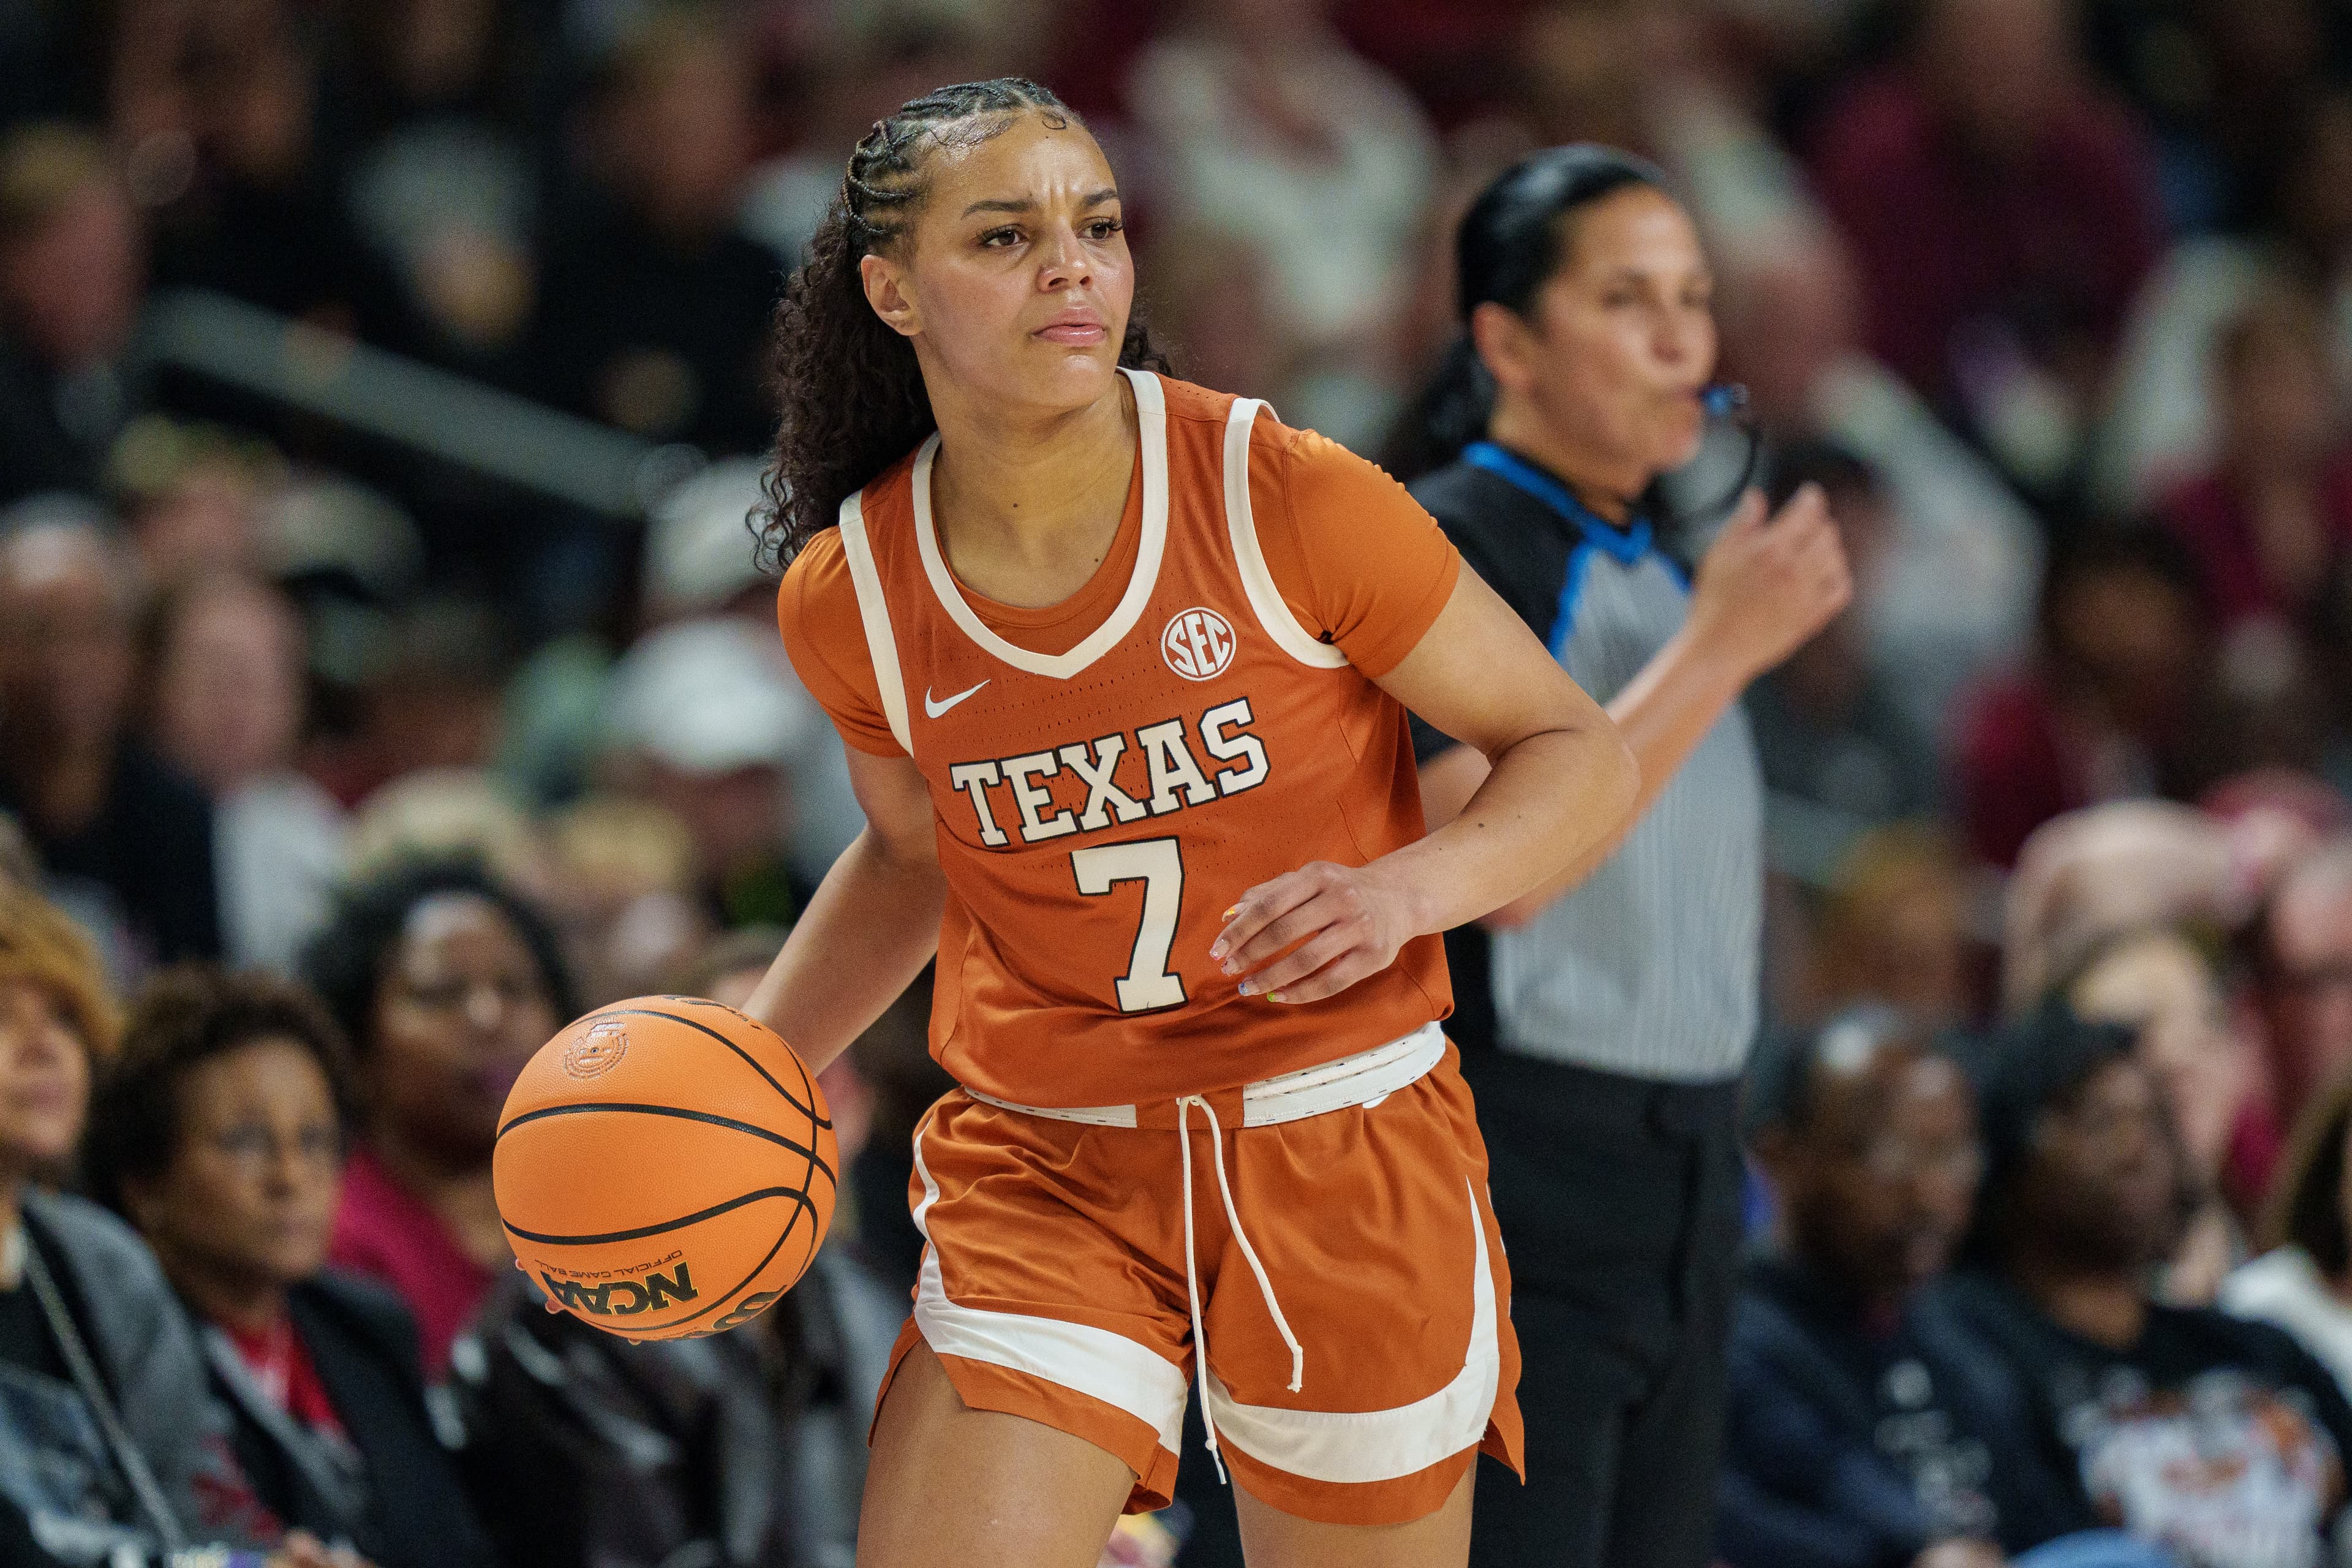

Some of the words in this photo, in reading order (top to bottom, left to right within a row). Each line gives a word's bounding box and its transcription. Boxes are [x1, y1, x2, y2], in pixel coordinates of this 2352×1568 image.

[1167, 612, 1231, 676] SEC
[949, 696, 1271, 848] TEXAS
[1069, 835, 1189, 1014] 7
[534, 1259, 567, 1276] BALL
[540, 1261, 699, 1316] NCAA
[570, 1270, 611, 1279] GAME
[614, 1250, 683, 1276] OFFICIAL
